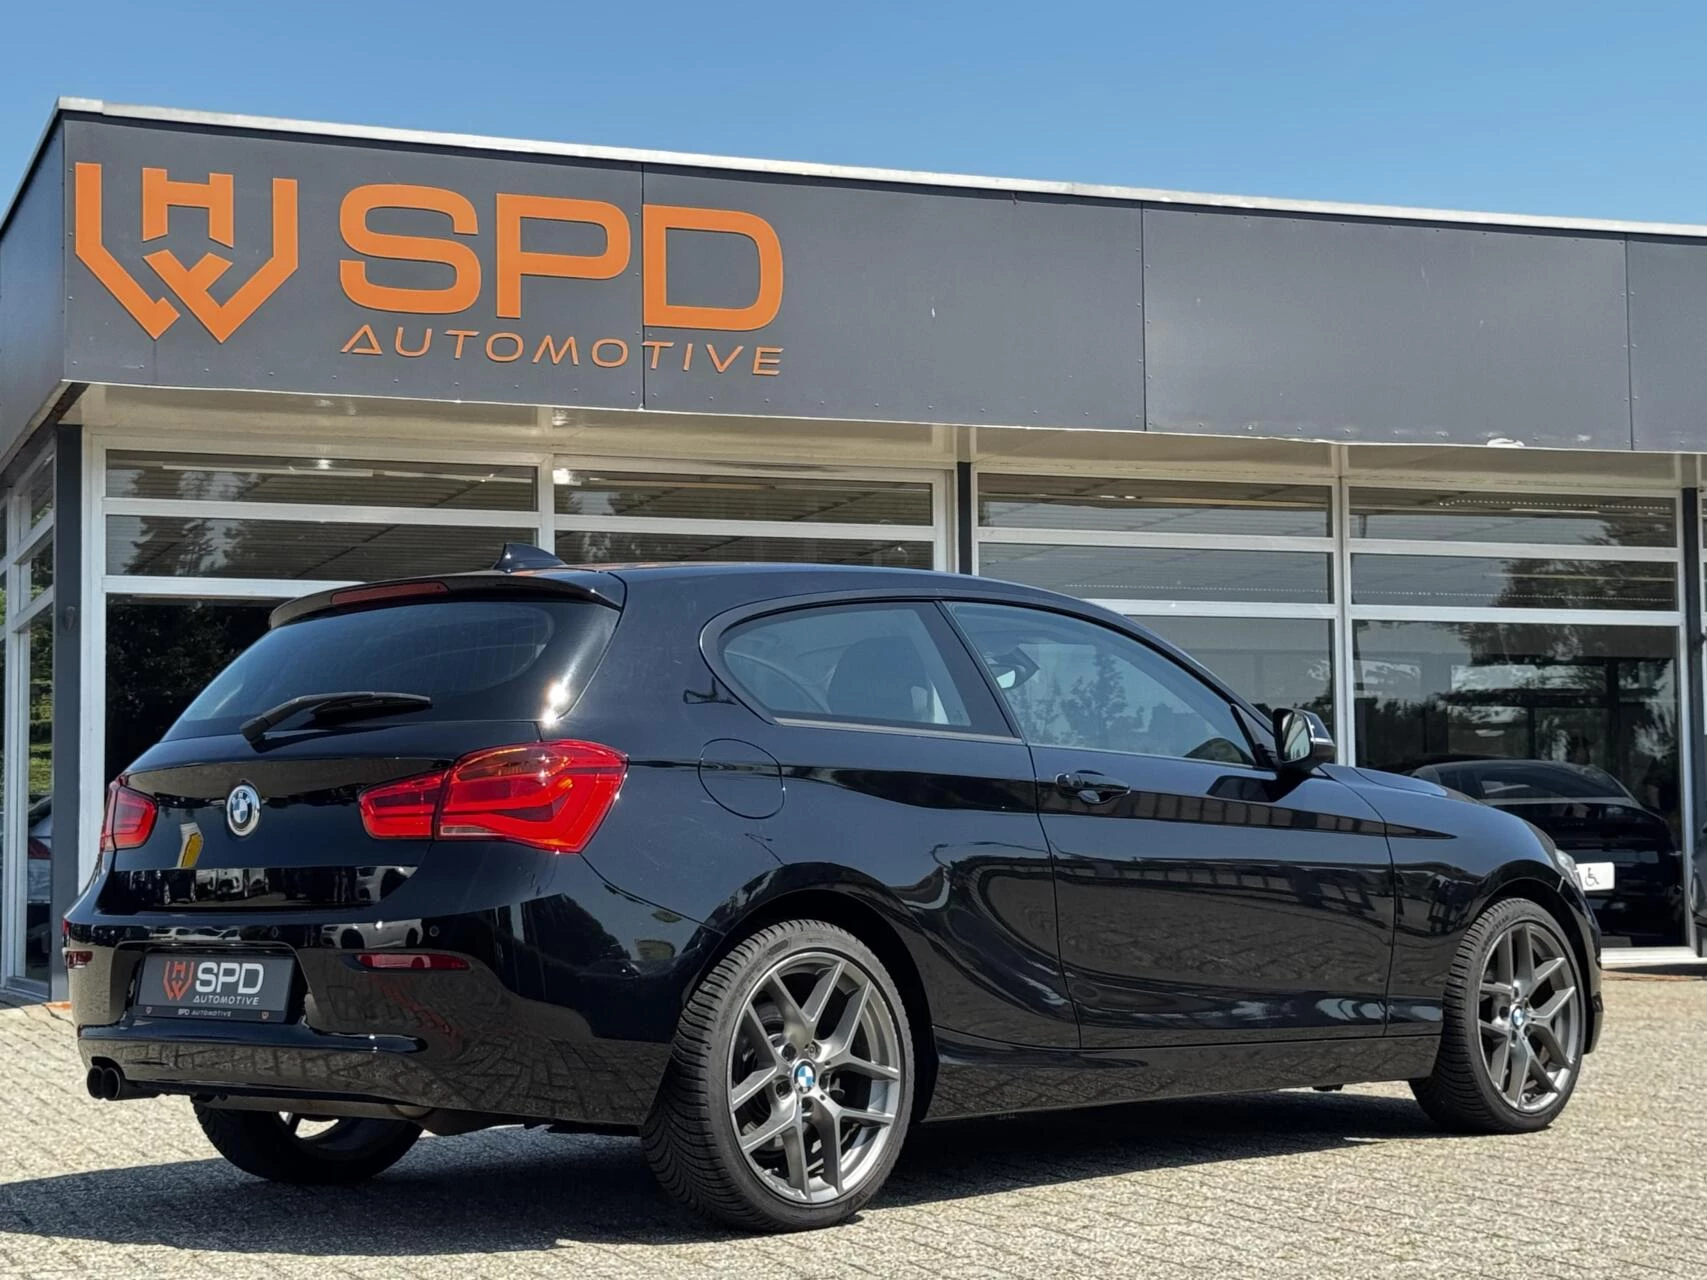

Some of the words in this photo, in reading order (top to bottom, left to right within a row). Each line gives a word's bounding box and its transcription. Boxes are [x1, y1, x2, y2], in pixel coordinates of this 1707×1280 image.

[339, 184, 784, 331] SPD
[341, 324, 784, 376] AUTOMOTIVE
[195, 961, 264, 994] SPD
[177, 1008, 190, 1016] SPD
[191, 1009, 232, 1017] AUTOMOTIVE
[193, 995, 260, 1006] AUTOMOTIVE
